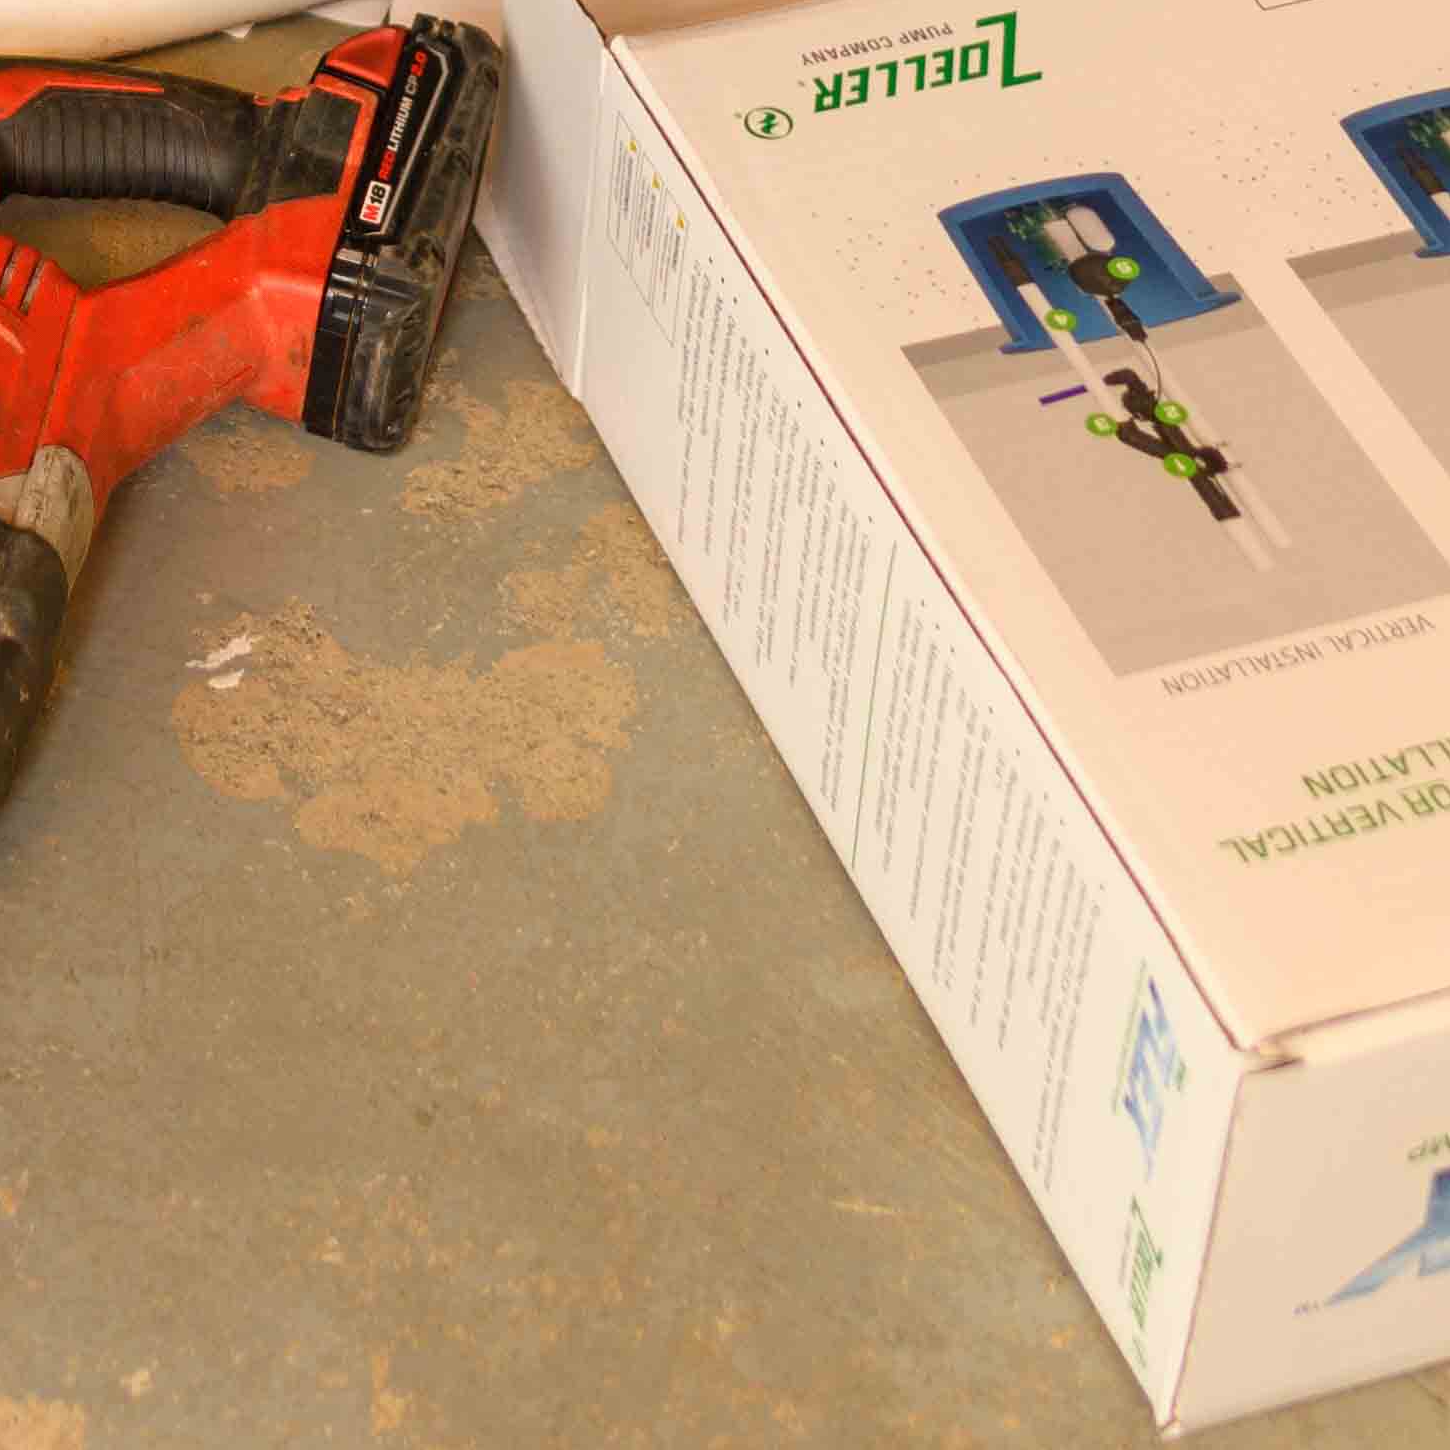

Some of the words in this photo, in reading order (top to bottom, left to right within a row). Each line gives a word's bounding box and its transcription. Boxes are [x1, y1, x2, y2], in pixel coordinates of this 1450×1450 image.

[798, 32, 894, 67] COMPANY
[898, 19, 953, 45] PUMP
[811, 10, 1042, 114] ZOELLER
[362, 184, 387, 221] M18
[1325, 612, 1435, 654] VERTICAL
[1160, 637, 1325, 698] INSTALLATION
[1219, 796, 1403, 869] VERTICAL
